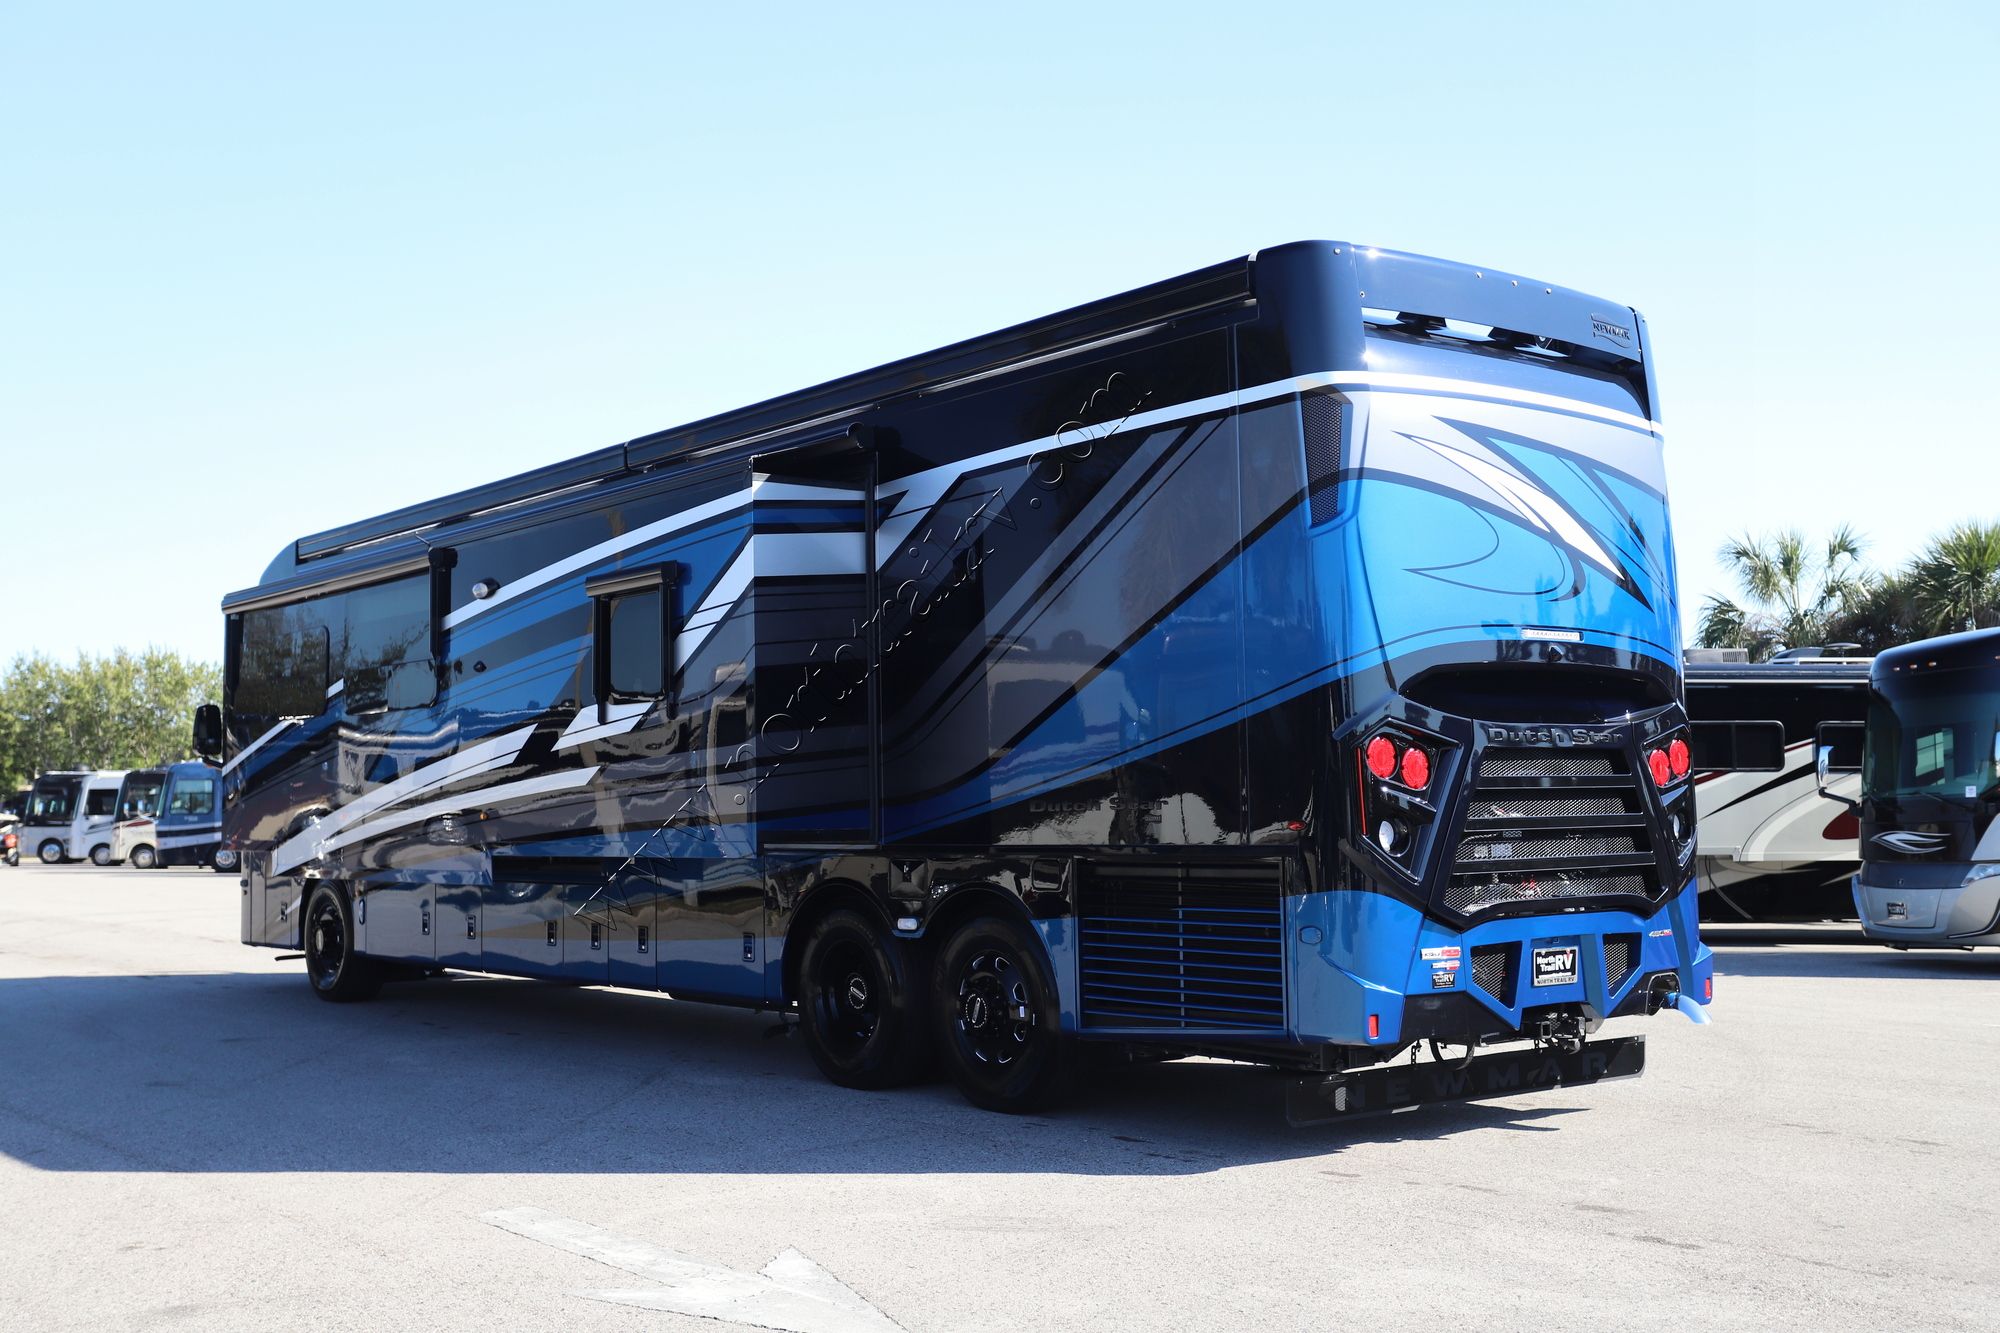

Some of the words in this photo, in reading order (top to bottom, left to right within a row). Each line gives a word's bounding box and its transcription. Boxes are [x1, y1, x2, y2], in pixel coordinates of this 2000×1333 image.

[1488, 728, 1565, 744] Dutch
[1572, 728, 1623, 744] Star
[1537, 955, 1556, 964] North
[1555, 953, 1574, 970] RV
[1540, 963, 1556, 971] Trail
